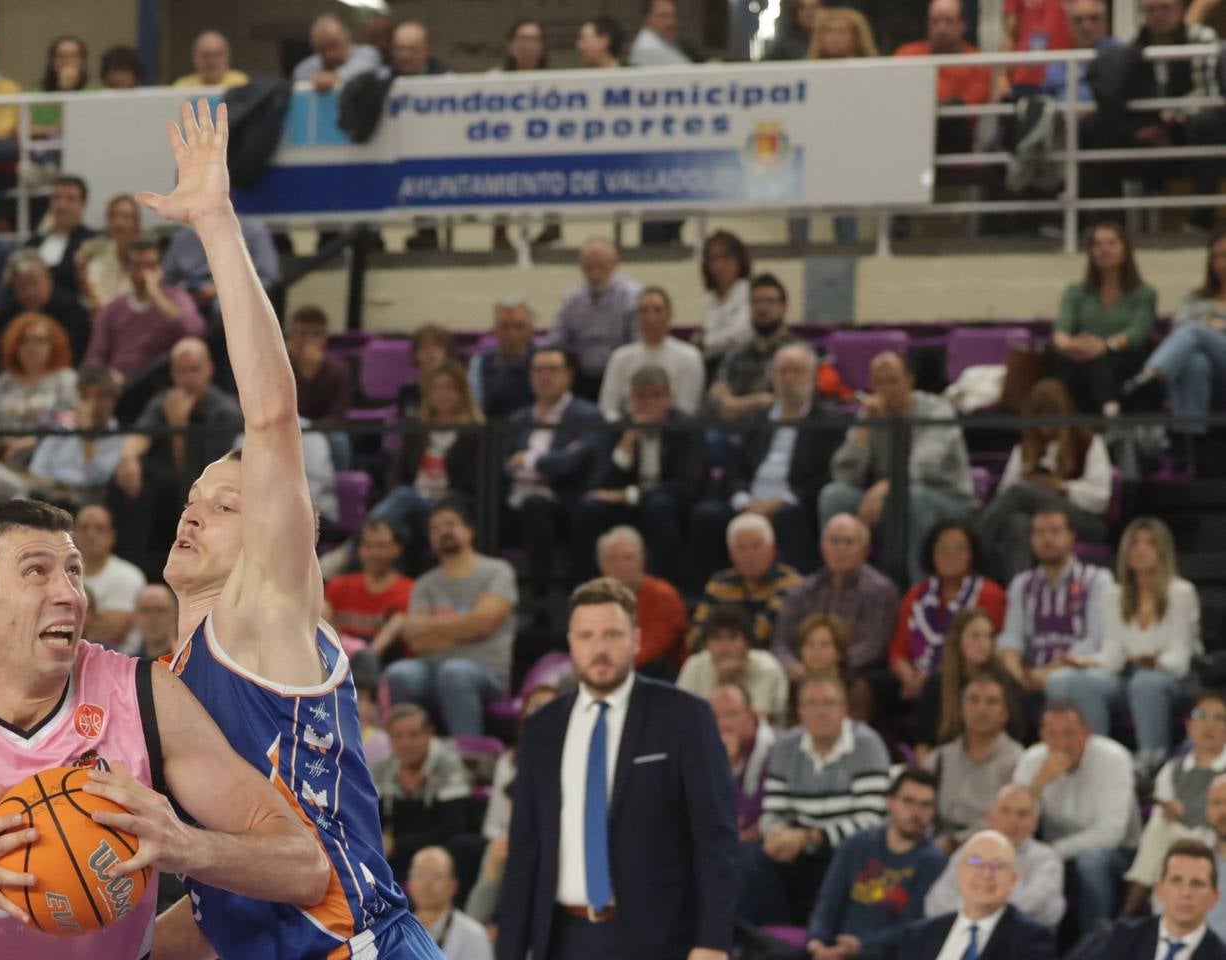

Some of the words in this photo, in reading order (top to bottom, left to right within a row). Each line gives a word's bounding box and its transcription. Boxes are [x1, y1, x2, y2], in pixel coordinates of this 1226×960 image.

[389, 87, 589, 118] Fundación
[603, 80, 808, 110] Municipal
[467, 119, 512, 142] de
[526, 115, 730, 142] Deportes
[400, 171, 567, 198] AYUNTAMIENTO
[570, 170, 601, 195] DE
